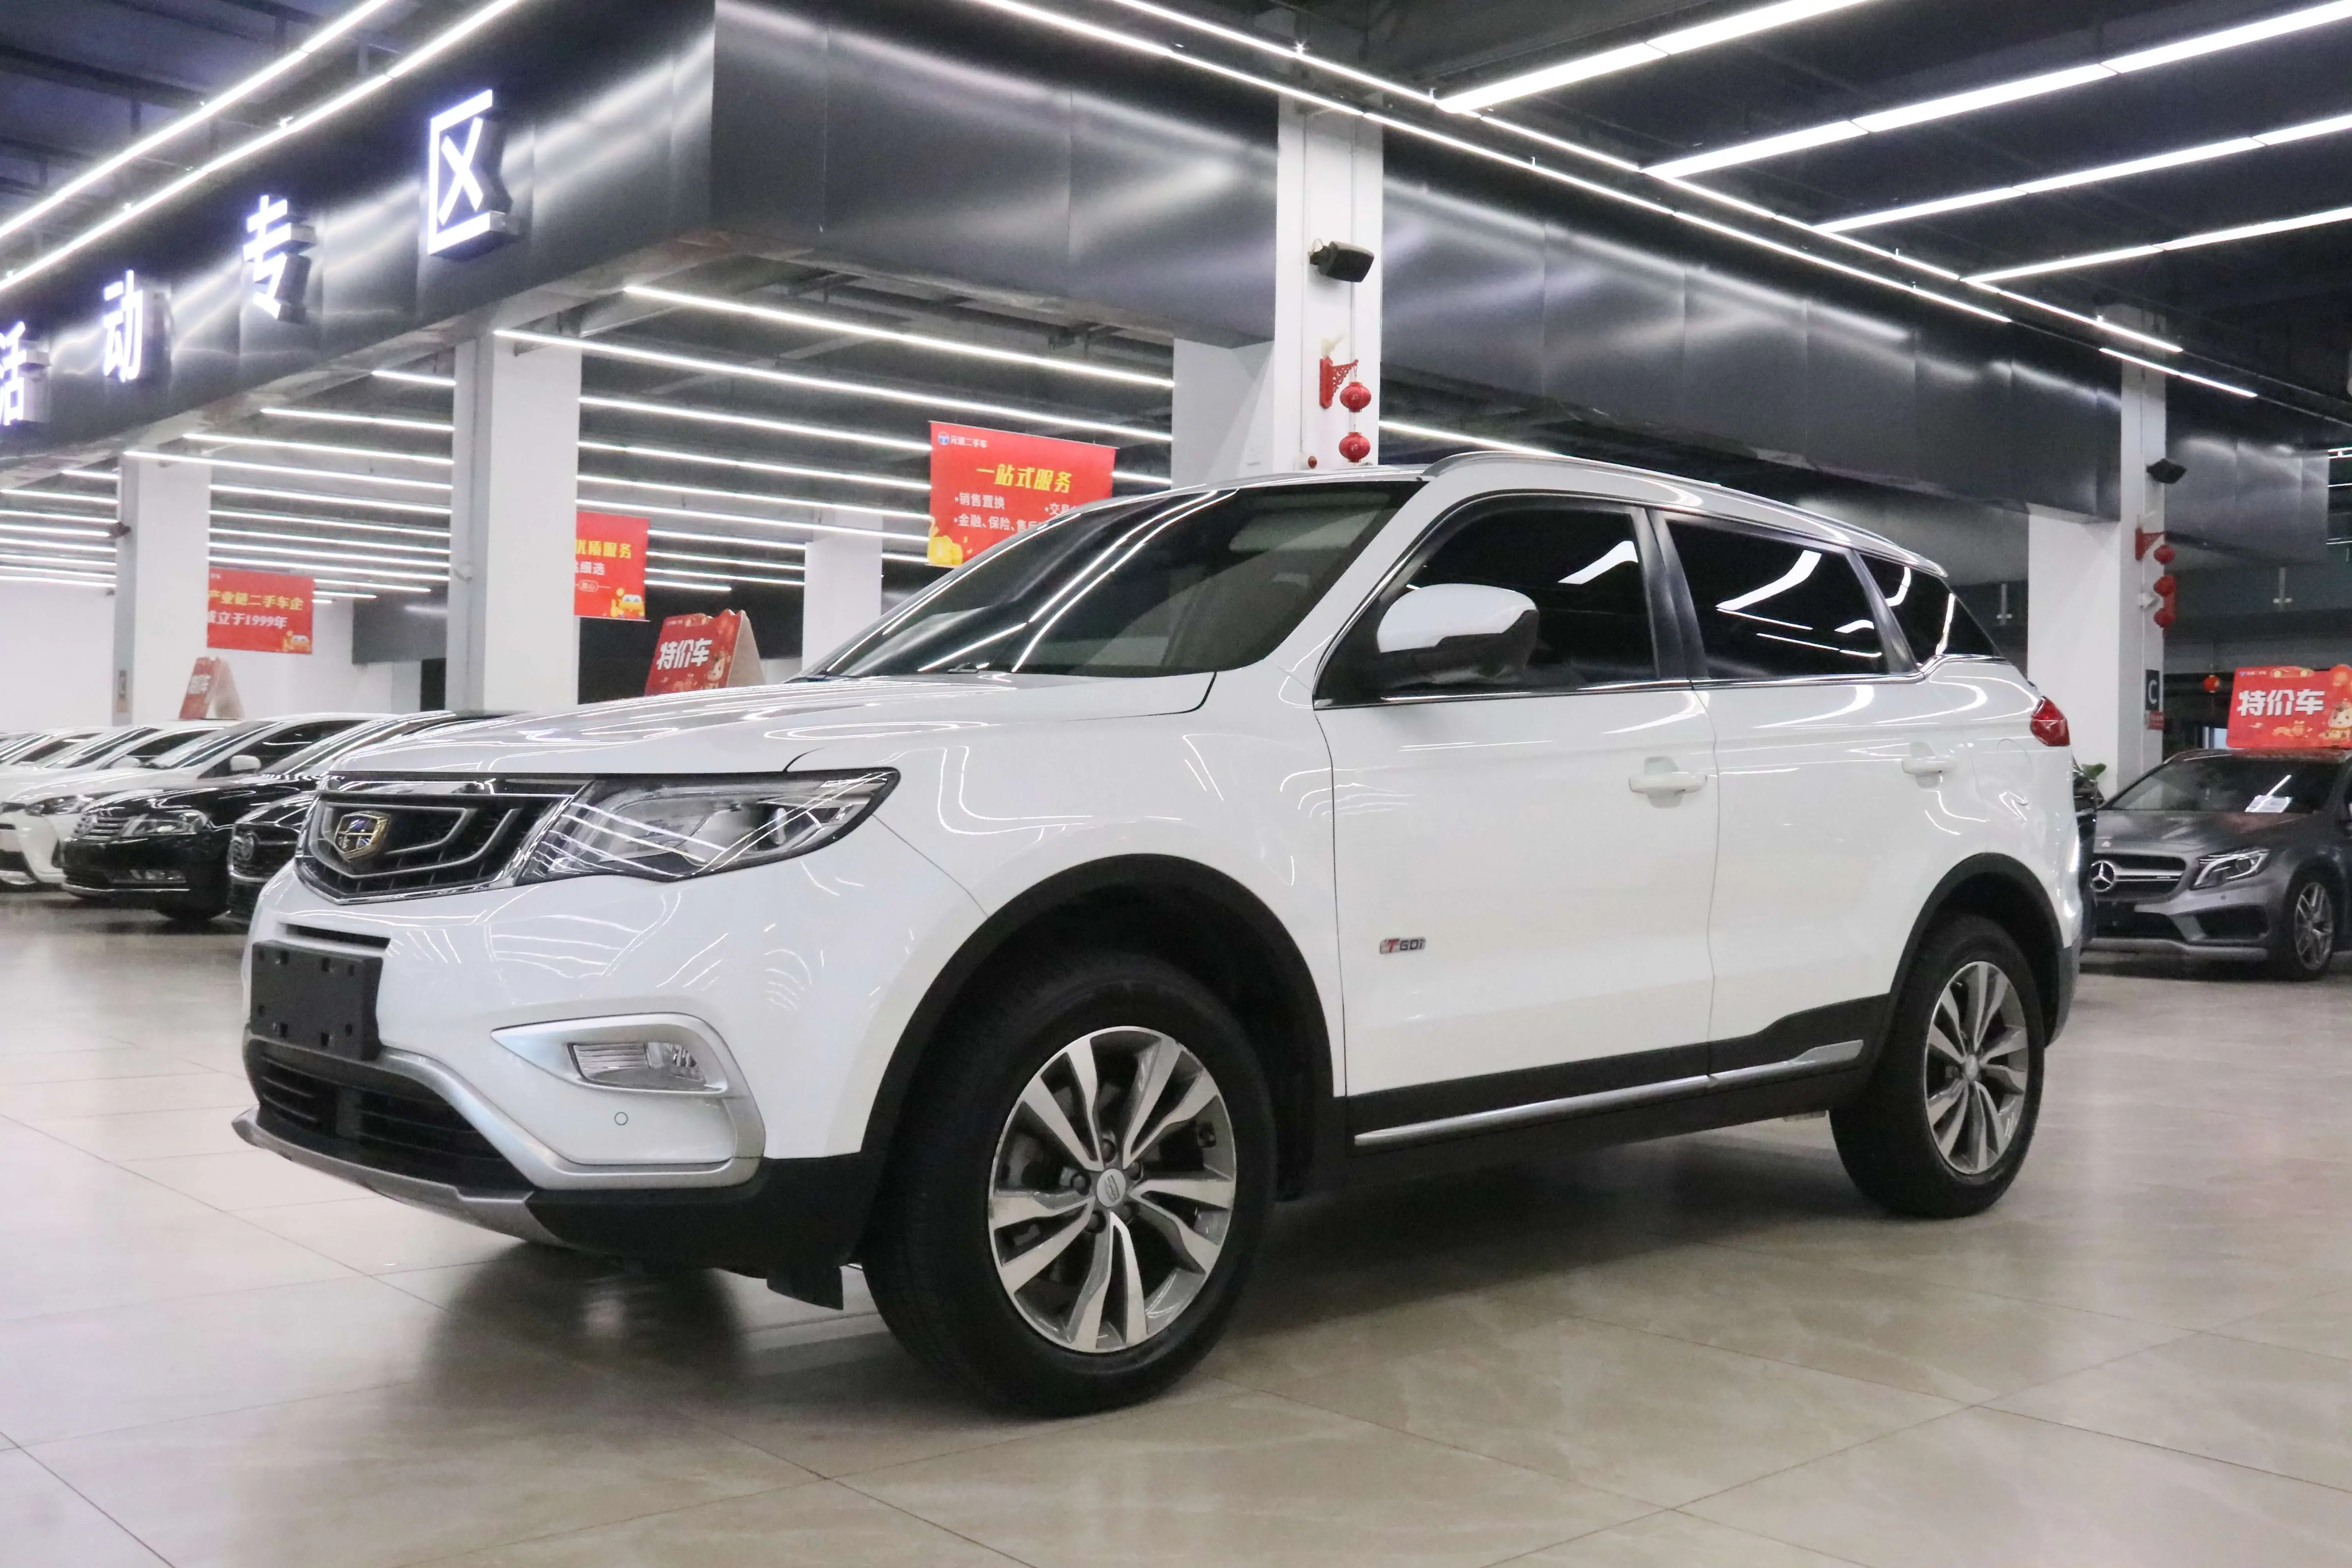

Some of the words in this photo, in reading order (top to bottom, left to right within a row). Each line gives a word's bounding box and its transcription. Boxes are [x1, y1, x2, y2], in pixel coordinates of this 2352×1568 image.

[0, 89, 494, 426] 活动专区
[976, 463, 1073, 494] 一站式服务
[959, 492, 1005, 510] 销售置换
[656, 638, 713, 670] 特价车
[2148, 679, 2158, 704] C
[2237, 689, 2325, 716] 特价车
